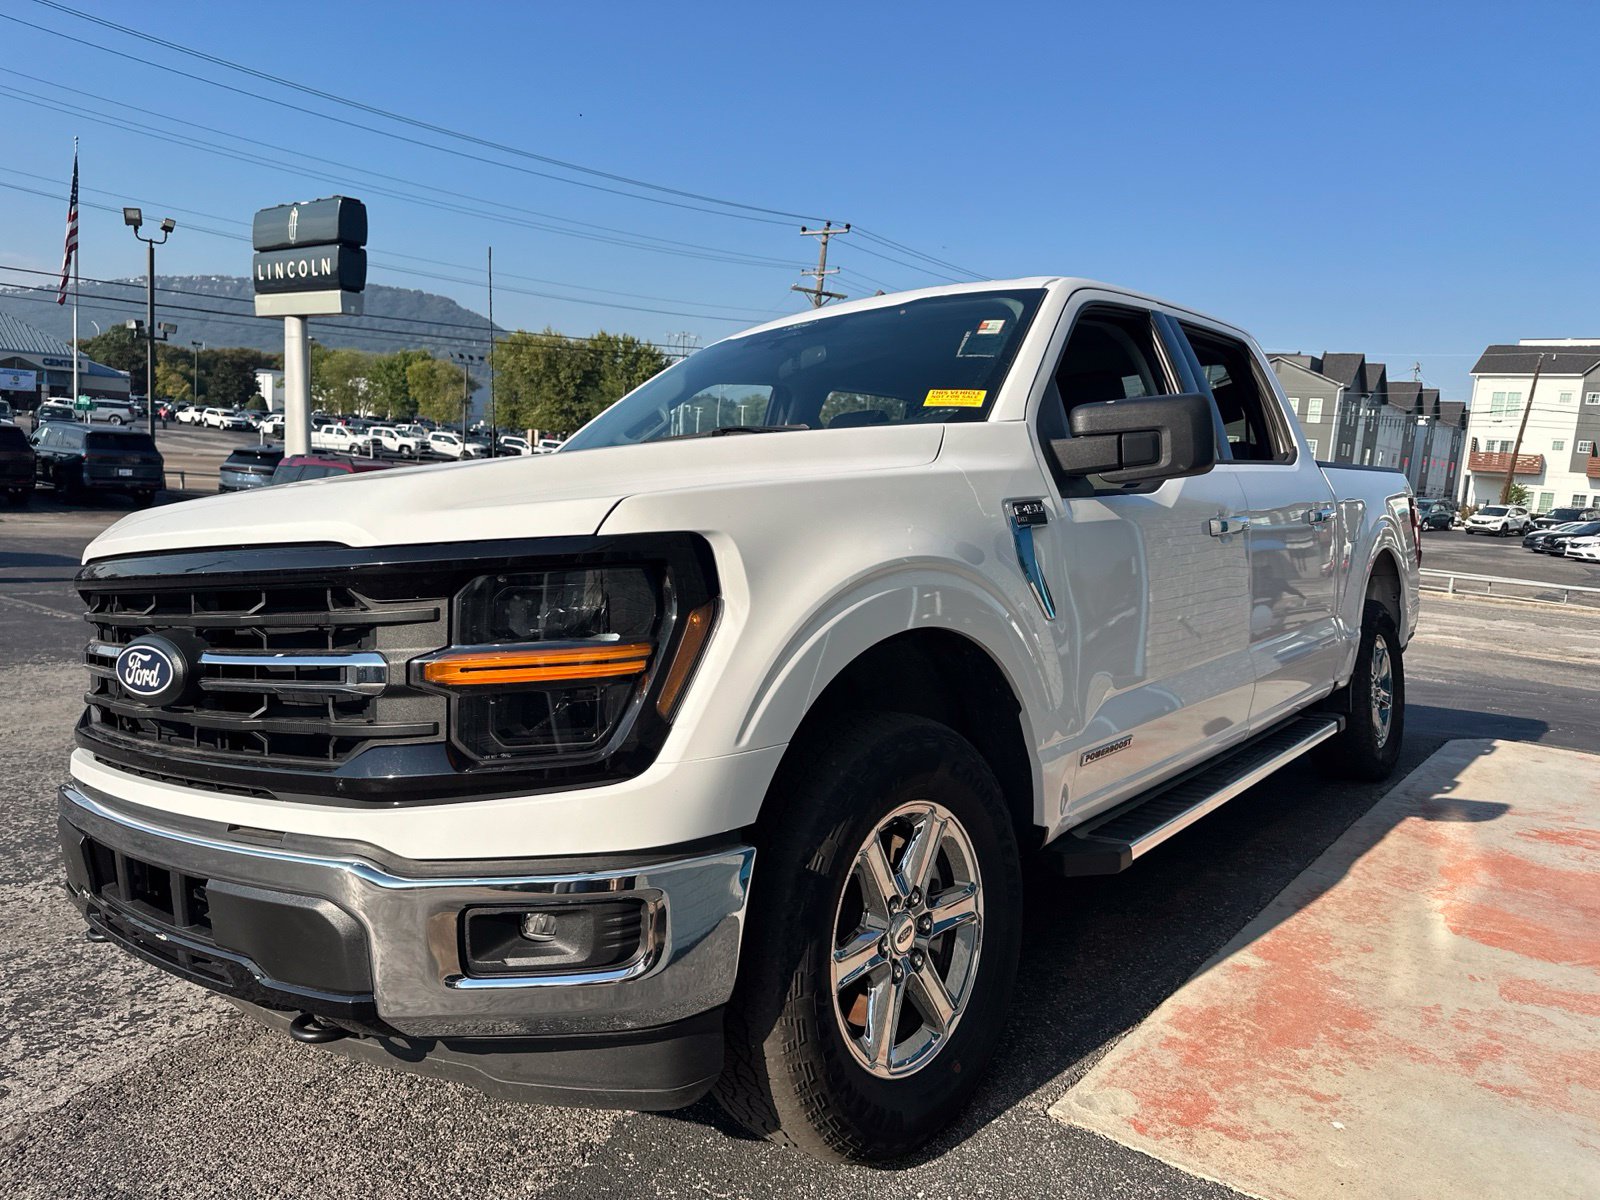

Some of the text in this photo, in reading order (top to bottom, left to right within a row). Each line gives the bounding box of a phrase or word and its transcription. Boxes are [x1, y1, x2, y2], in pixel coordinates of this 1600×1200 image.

[258, 257, 331, 280] LINCOLN
[125, 651, 160, 687] Ford
[1085, 737, 1132, 762] POWERBOOST
